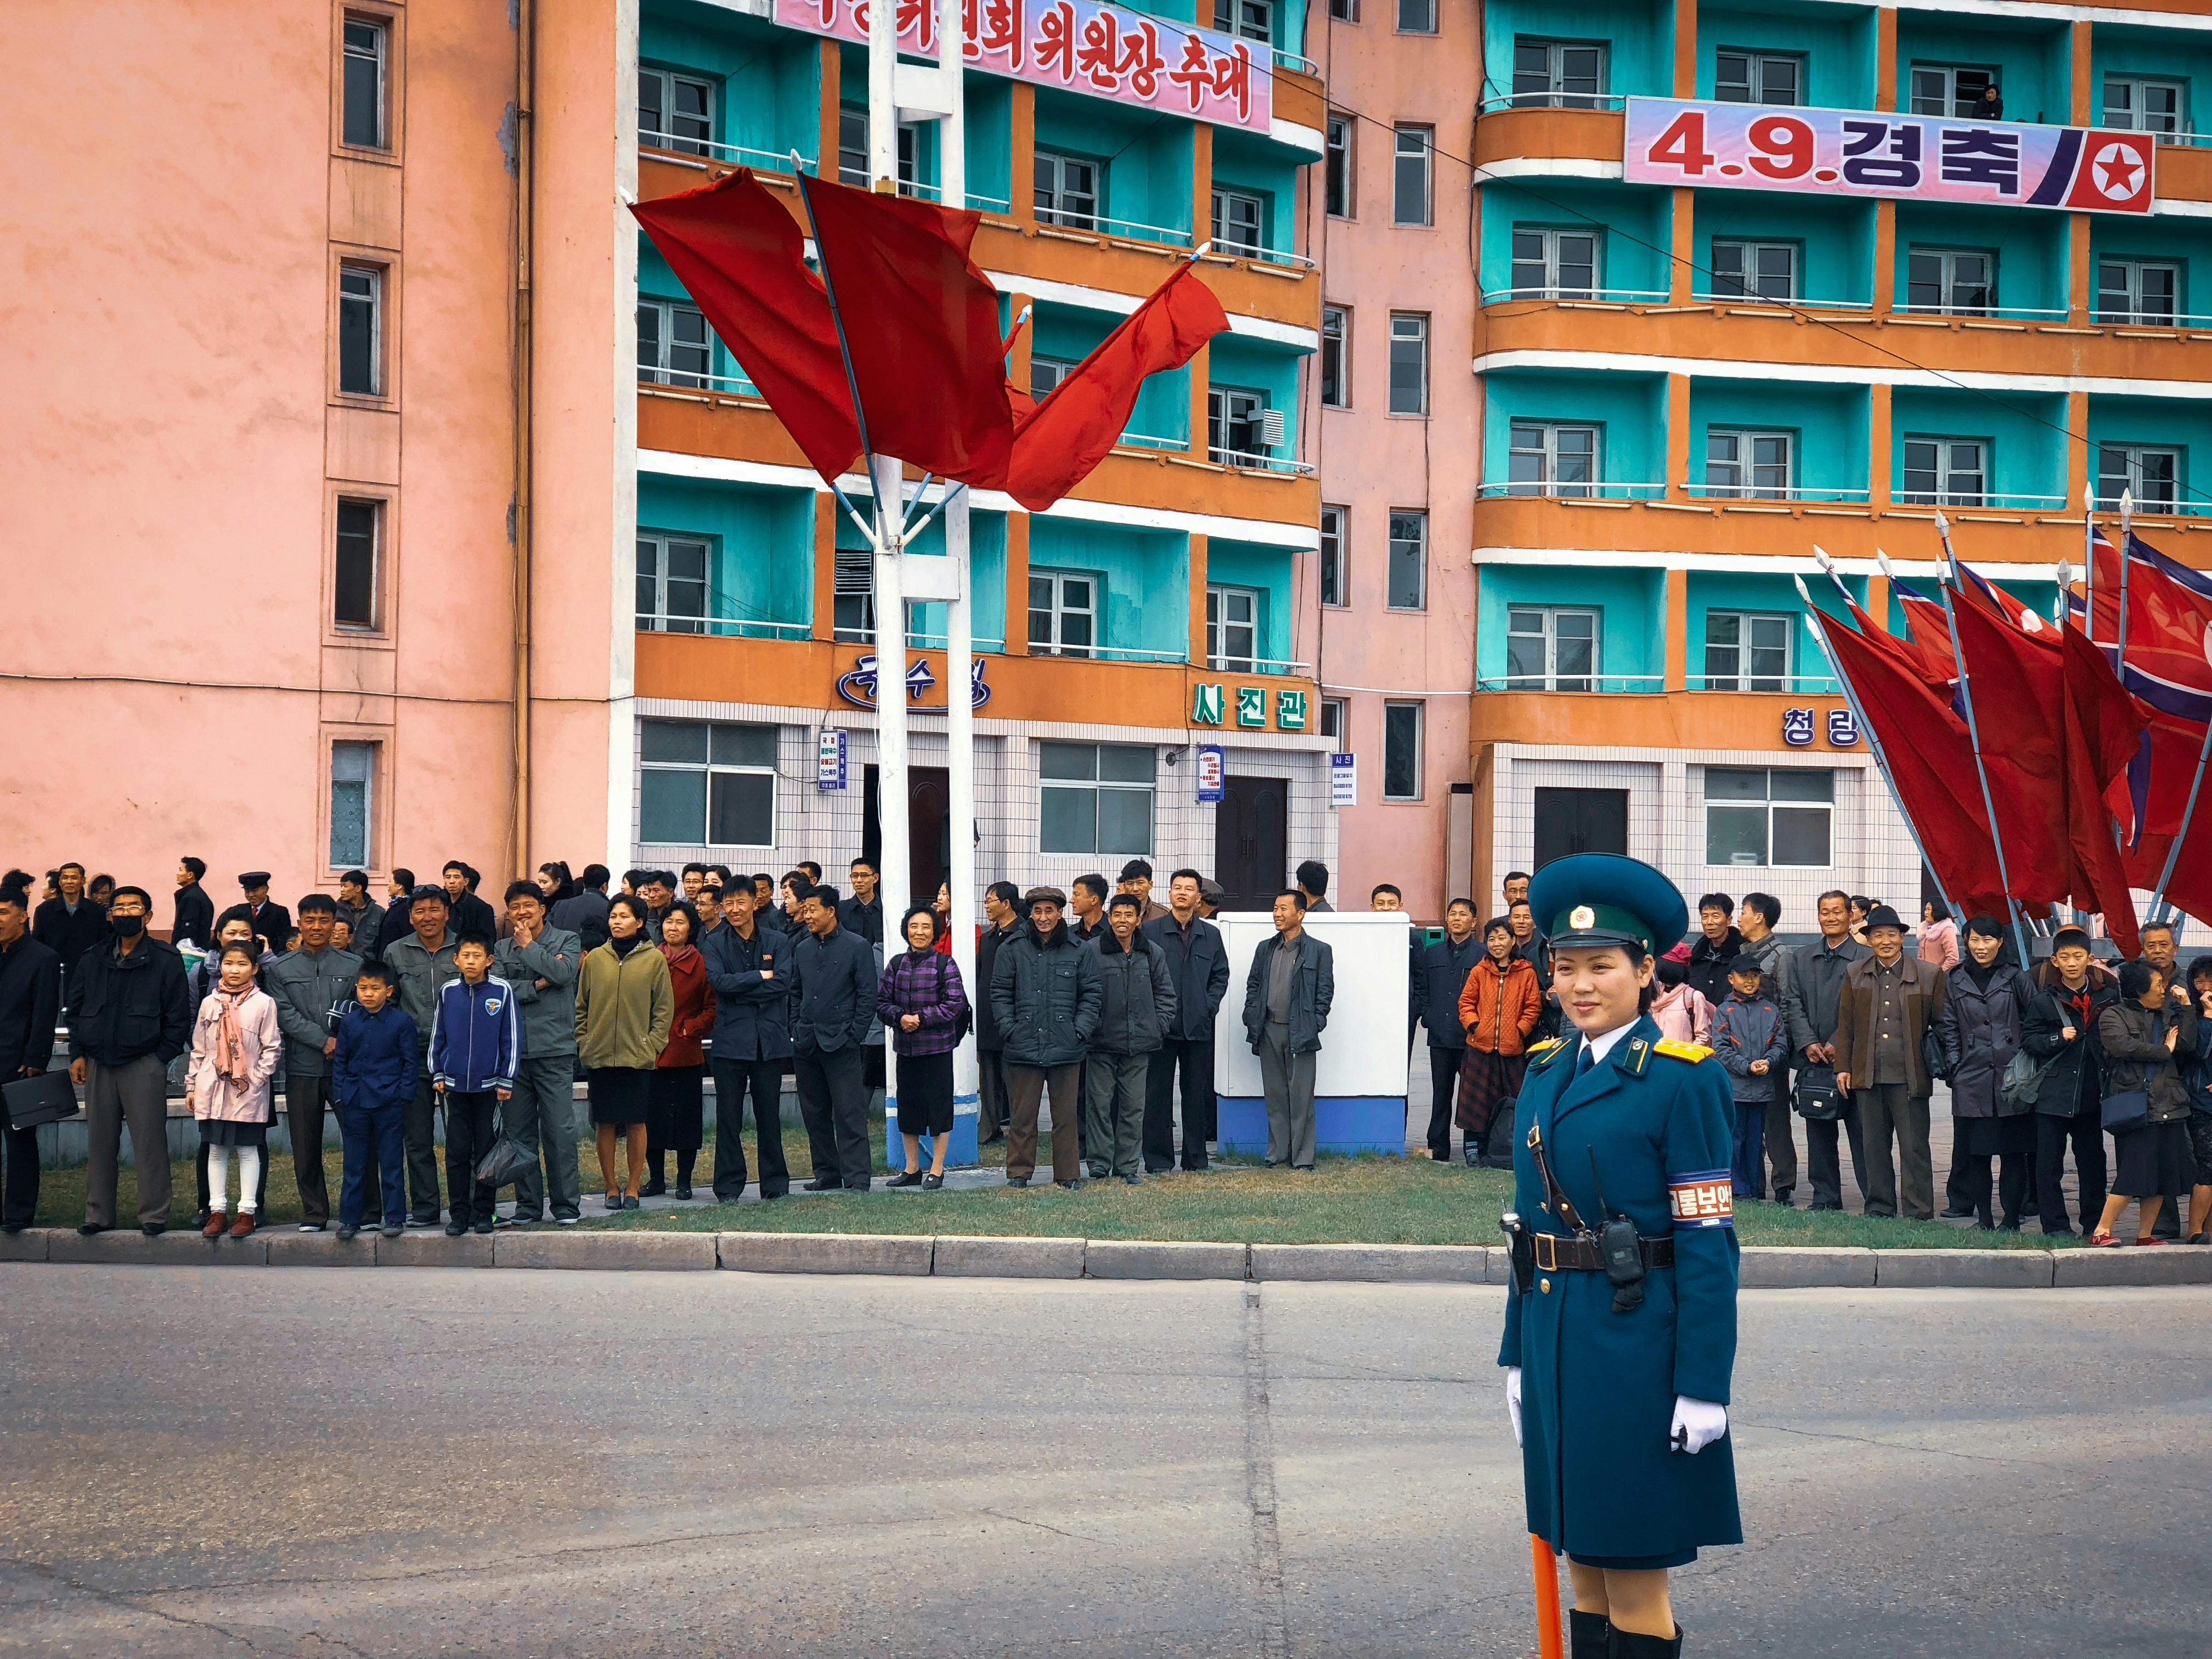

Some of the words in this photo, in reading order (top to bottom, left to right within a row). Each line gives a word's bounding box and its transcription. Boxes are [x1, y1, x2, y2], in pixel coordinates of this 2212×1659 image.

[1034, 2, 1164, 96] 위원장
[1170, 35, 1249, 119] 추대
[1192, 684, 1307, 729] 사진관
[1336, 755, 1350, 764] 사진
[1669, 1185, 1733, 1216] 통보안
